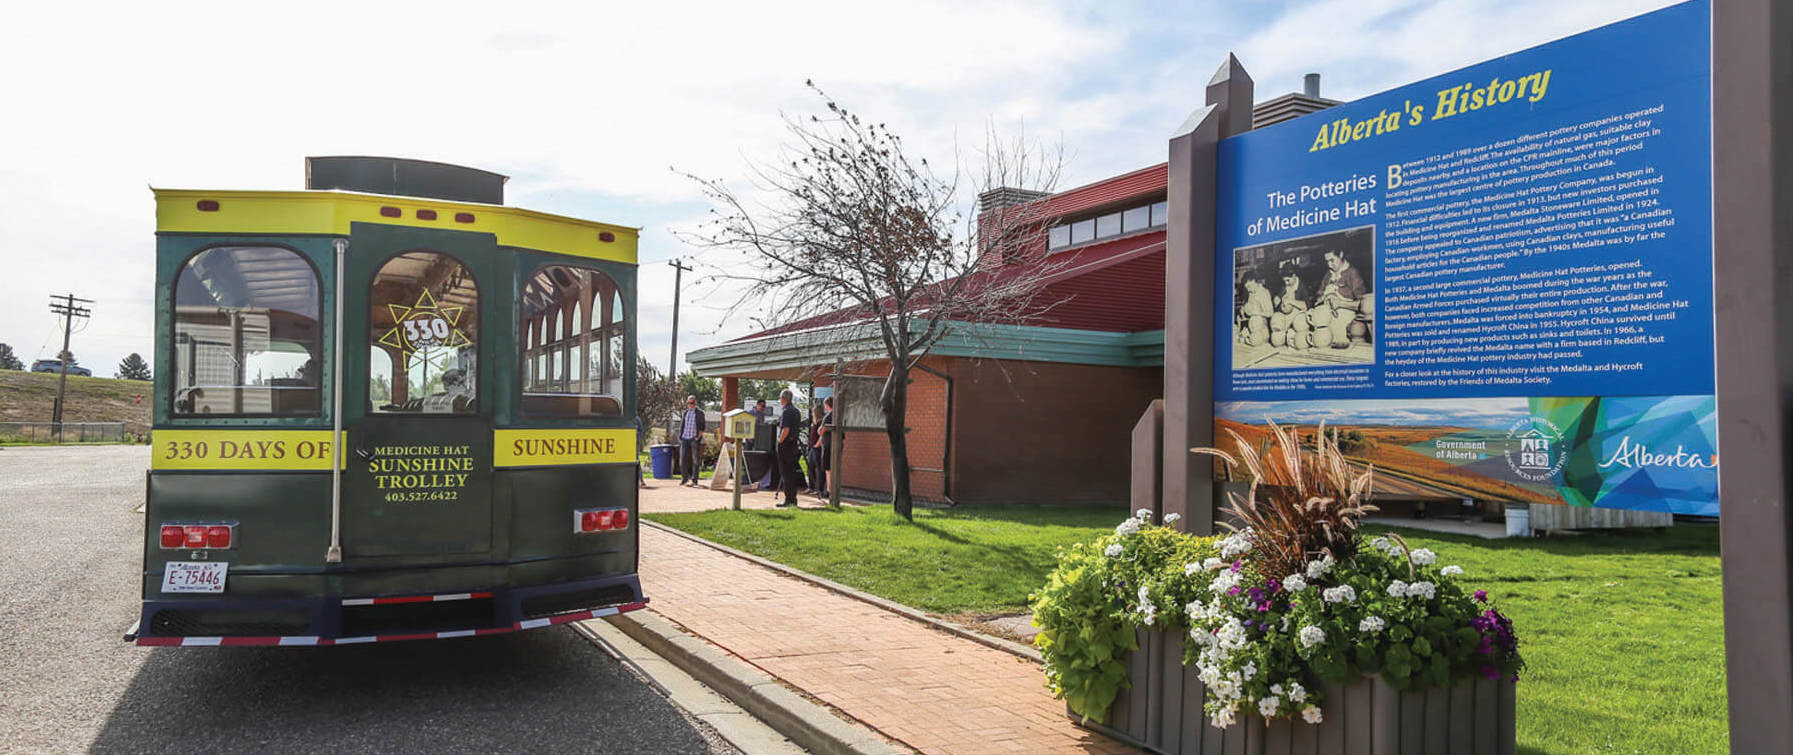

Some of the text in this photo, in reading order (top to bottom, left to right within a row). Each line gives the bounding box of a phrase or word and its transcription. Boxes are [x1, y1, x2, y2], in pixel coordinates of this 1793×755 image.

[1309, 69, 1552, 152] Alberta's History
[1517, 130, 1548, 143] different
[1549, 125, 1578, 138] pottery
[1579, 115, 1623, 130] companies
[1624, 104, 1664, 120] operated
[1505, 142, 1543, 156] availability
[1544, 139, 1553, 147] of
[1554, 132, 1582, 145] natural
[1599, 123, 1633, 136] suitable
[1634, 120, 1650, 129] clay
[1523, 152, 1538, 162] CPR
[1574, 142, 1594, 151] were
[1595, 137, 1620, 147] major
[1621, 130, 1651, 142] factors
[1652, 128, 1662, 136] in
[1520, 141, 1644, 173] Throughout much of this period
[1516, 188, 1529, 197] Hat
[1530, 184, 1558, 194] Pottery
[1598, 174, 1615, 182] was
[1616, 169, 1644, 179] begun
[1645, 166, 1654, 174] in
[1531, 167, 1573, 182] production
[1267, 174, 1377, 209] The Potteries
[1547, 192, 1561, 202] but
[1562, 191, 1579, 199] new
[1580, 184, 1617, 196] investors
[1618, 175, 1664, 192] purchased
[1510, 207, 1540, 218] Medalta
[1541, 201, 1581, 213] Stoneware
[1616, 188, 1649, 202] opened
[1650, 188, 1660, 196] in
[1247, 198, 1377, 236] of Medicine Hat
[1525, 214, 1555, 225] Medalta
[1556, 209, 1592, 220] Potteries
[1593, 202, 1624, 215] Limited
[1625, 202, 1635, 210] in
[1534, 222, 1577, 234] advertising
[1578, 218, 1595, 228] that
[1596, 217, 1602, 225] it
[1603, 216, 1619, 224] was
[1630, 208, 1672, 220] Canadian
[1526, 235, 1561, 245] Canadian
[1584, 223, 1646, 237] manufacturing
[1647, 217, 1676, 229] useful
[1534, 231, 1666, 254] the 1940s Medalta was by far the
[1512, 280, 1543, 290] boomed
[1544, 279, 1570, 287] during
[1571, 276, 1585, 285] the
[1602, 273, 1625, 283] years
[1637, 269, 1654, 278] the
[1520, 270, 1554, 280] Medicine
[1555, 267, 1568, 276] Hat
[1515, 300, 1560, 310] competition
[1581, 296, 1603, 304] other
[1604, 293, 1645, 303] Canadian
[1646, 290, 1664, 299] and
[1521, 291, 1538, 300] their
[1539, 289, 1562, 298] entire
[1611, 283, 1632, 291] After
[1633, 281, 1649, 289] the
[1519, 312, 1533, 320] into
[1534, 308, 1578, 318] bankruptcy
[1579, 307, 1588, 315] in
[1612, 304, 1629, 313] and
[1630, 302, 1671, 311] Medicine
[1672, 299, 1690, 308] Hat
[403, 318, 449, 341] 330
[1508, 322, 1529, 330] China
[1560, 318, 1589, 328] Hycroft
[1590, 316, 1615, 325] China
[1616, 313, 1653, 323] survived
[1654, 311, 1678, 321] until
[1512, 332, 1529, 340] such
[1539, 330, 1558, 338] sinks
[1559, 329, 1574, 337] and
[1536, 341, 1553, 349] with
[1578, 338, 1603, 347] based
[1649, 334, 1666, 343] but
[1507, 352, 1537, 361] industry
[1538, 351, 1553, 359] had
[1530, 365, 1545, 373] visit
[1561, 364, 1593, 372] Medalta
[1594, 363, 1610, 371] and
[1611, 362, 1644, 372] Hycroft
[166, 440, 332, 460] 330 DAYS OF
[375, 446, 470, 456] MEDICINE HAT
[513, 438, 616, 456] SUNSHINE
[1436, 440, 1486, 450] Government
[1436, 450, 1477, 460] of Alberta
[1598, 435, 1718, 468] Alberta
[369, 457, 474, 472] SUNSHINE
[375, 474, 468, 489] TROLLEY
[385, 491, 458, 502] 403.527.6422
[168, 570, 221, 585] E-75446
